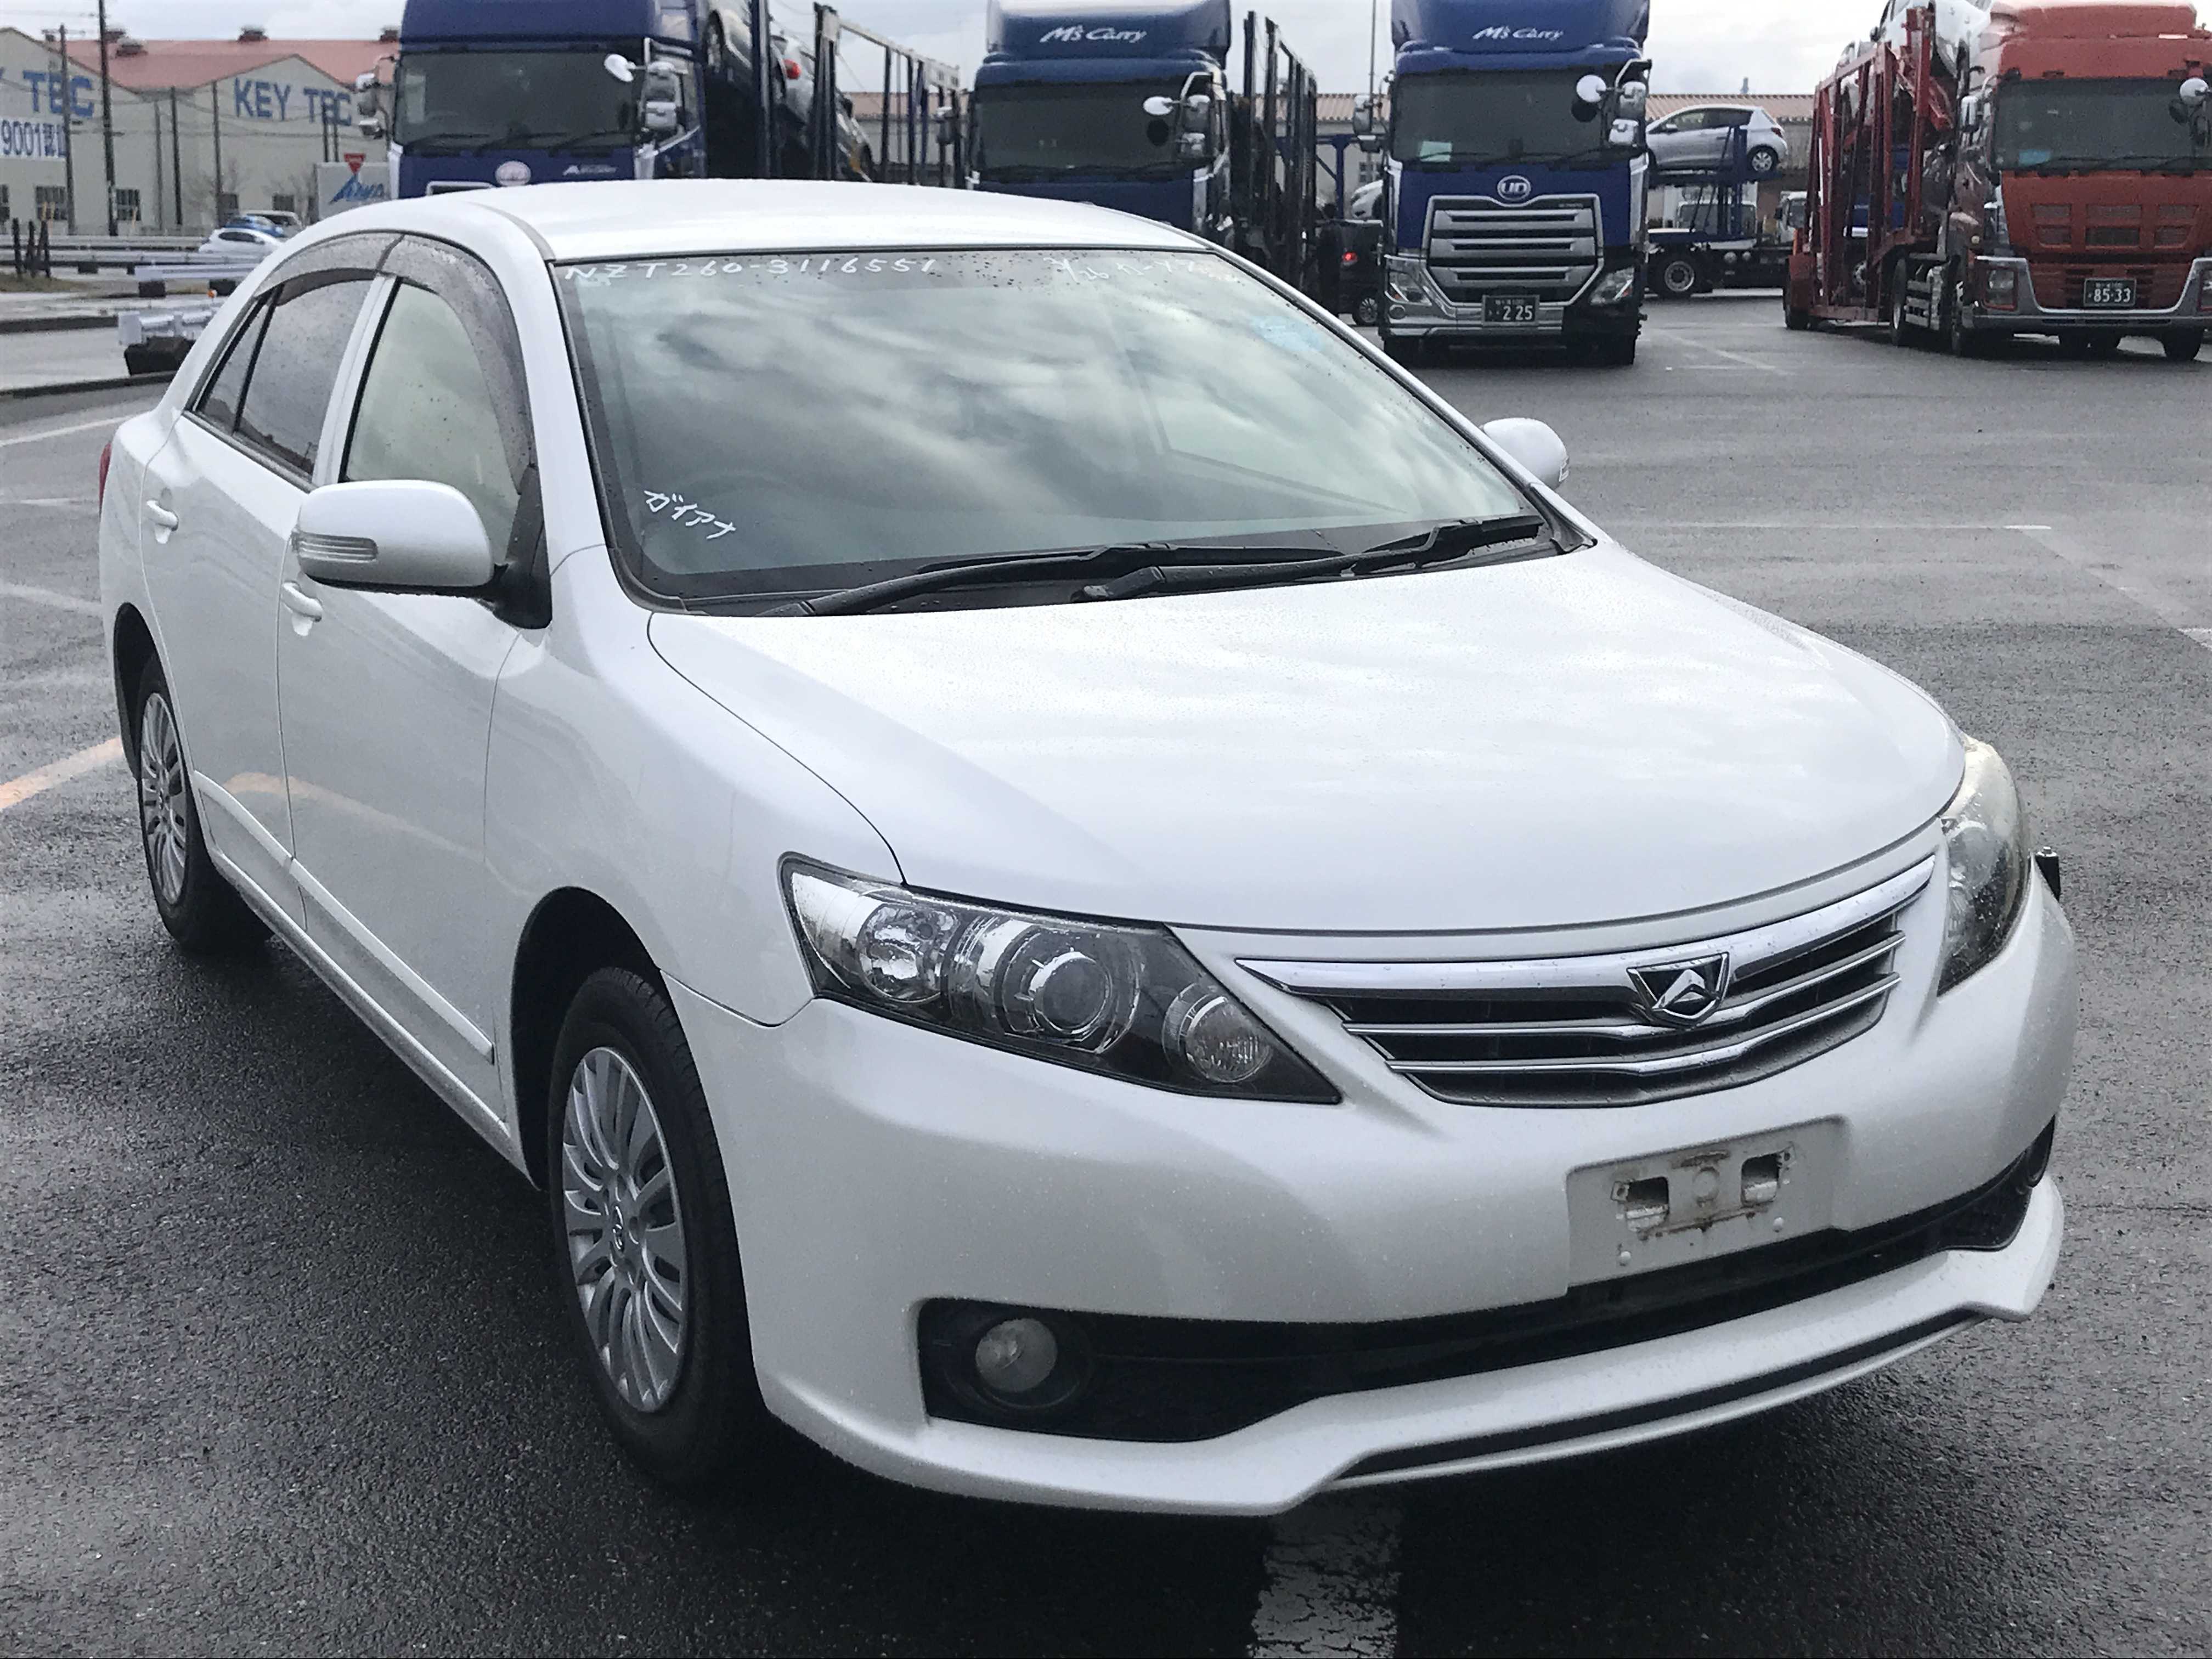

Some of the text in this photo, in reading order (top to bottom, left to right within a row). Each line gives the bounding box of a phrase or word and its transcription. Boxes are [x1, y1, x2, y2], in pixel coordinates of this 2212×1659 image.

[1086, 27, 1148, 43] Carry
[1513, 27, 1564, 41] Carry
[22, 70, 94, 119] TEC
[234, 77, 352, 127] KEY TEC
[644, 490, 737, 540] ガイアナ
